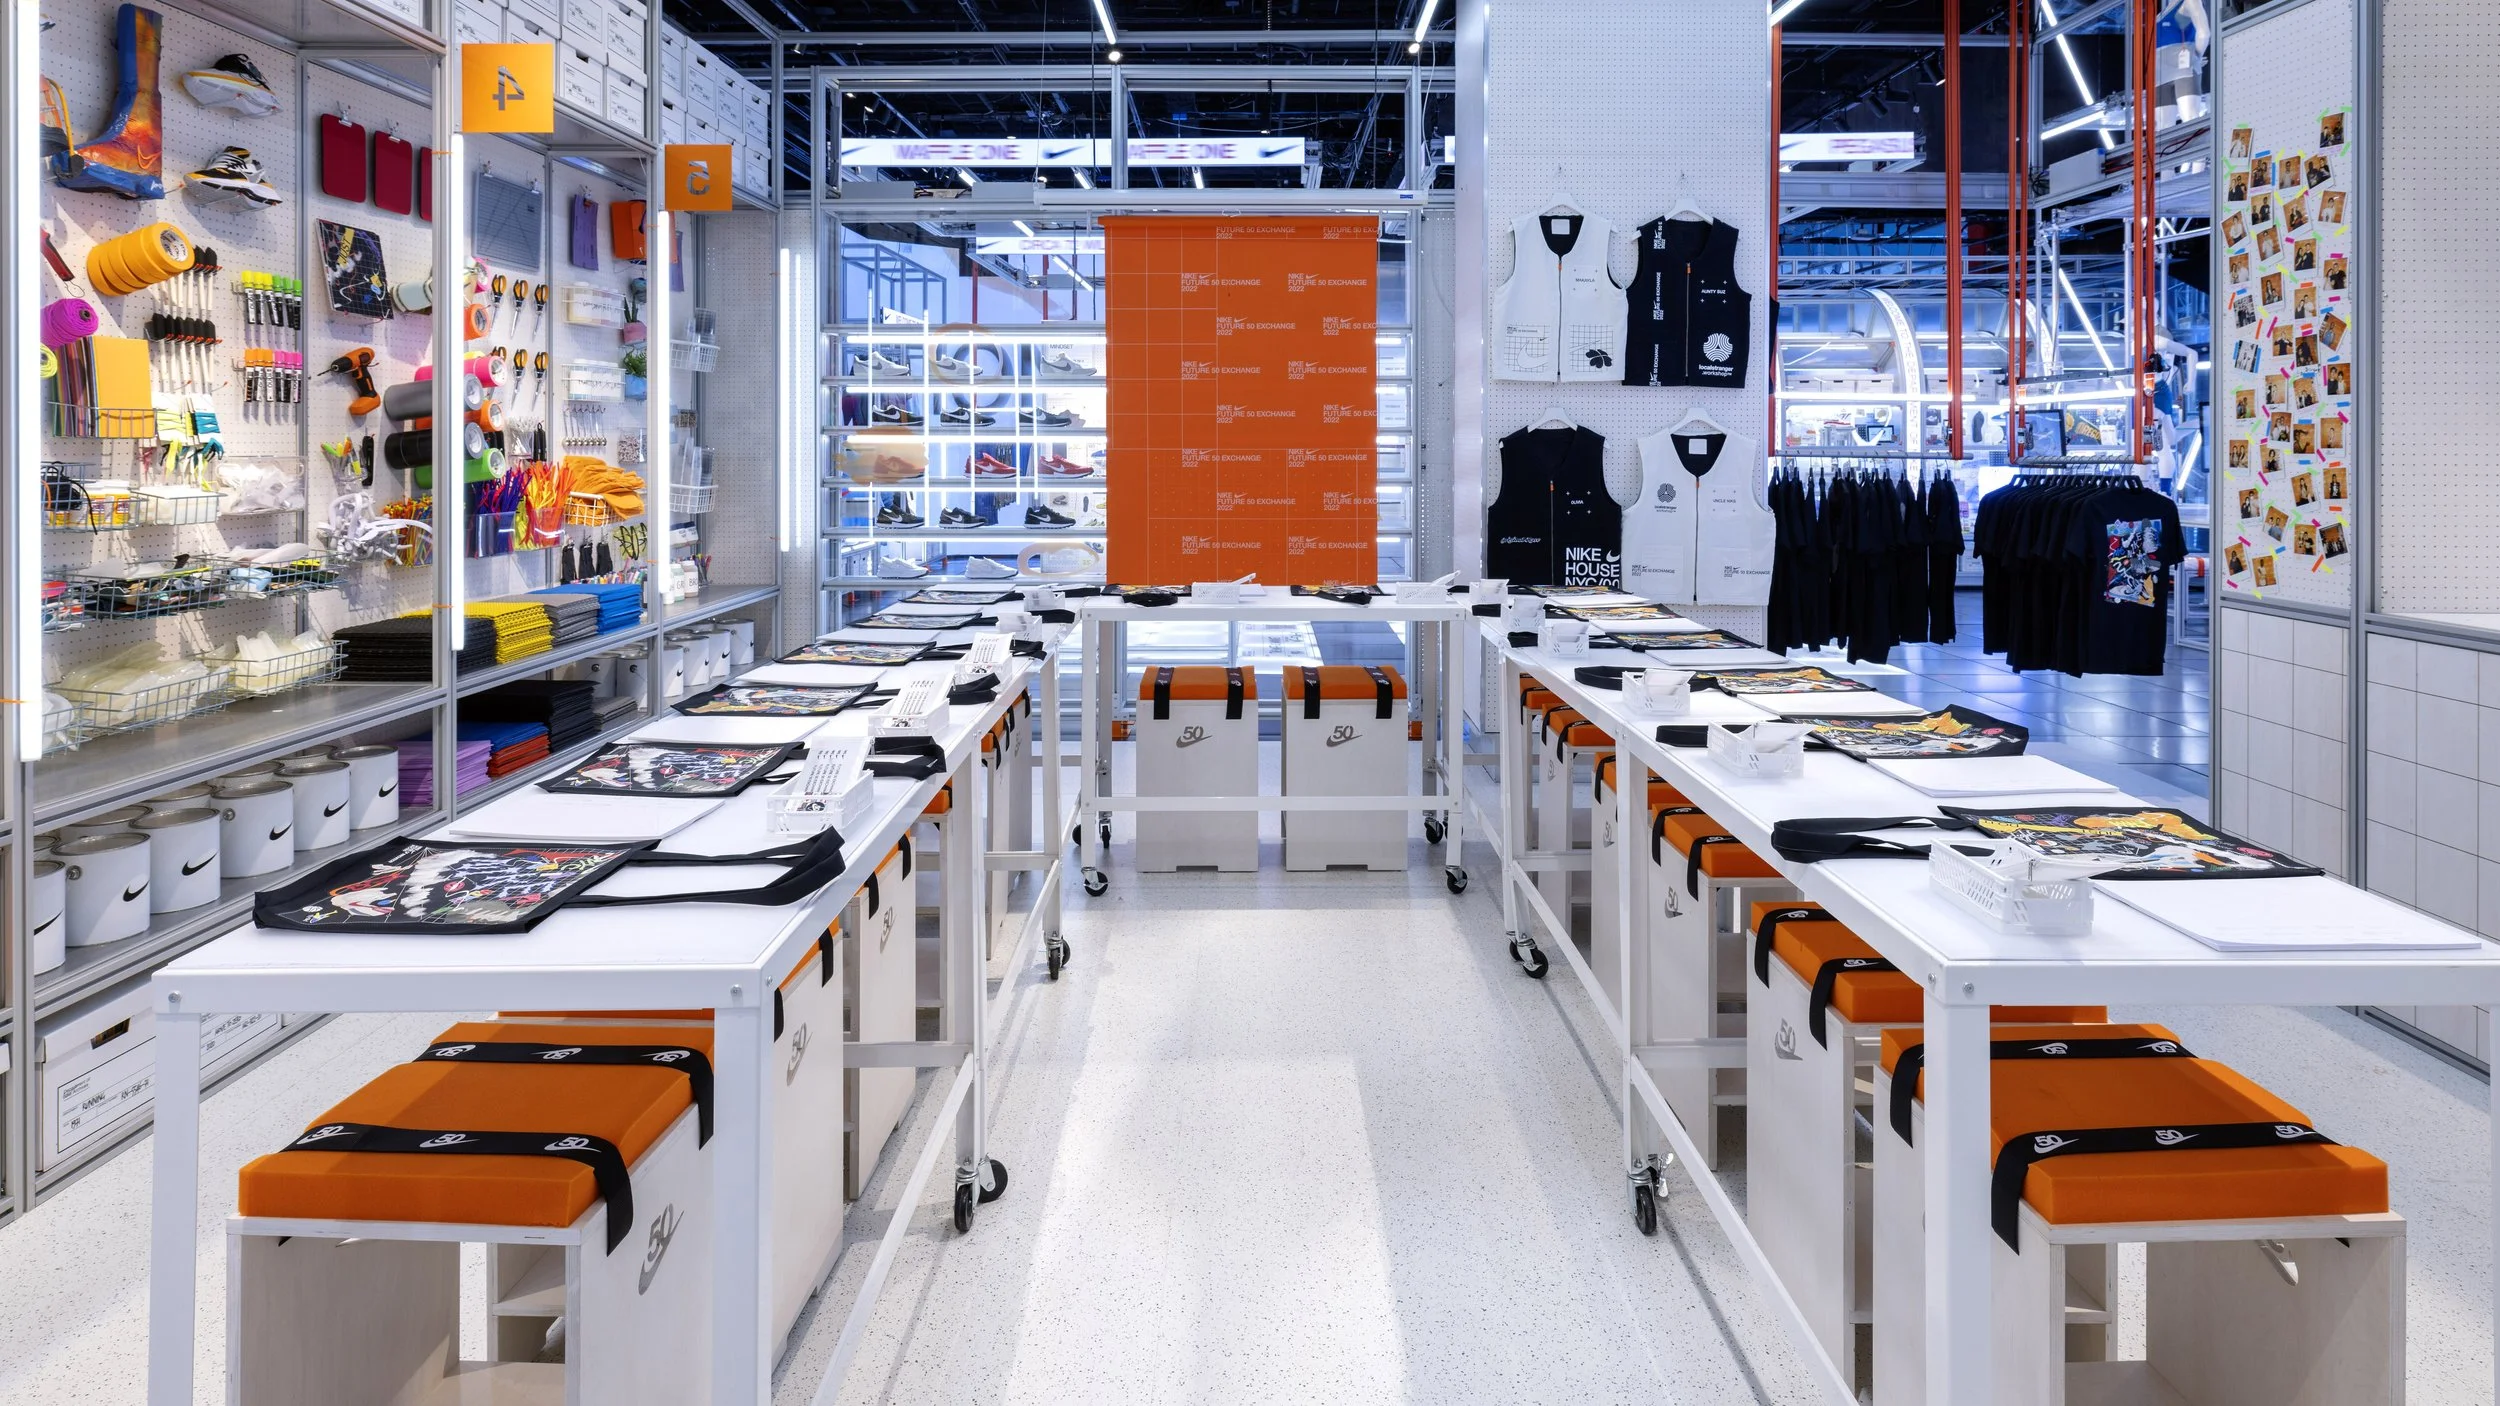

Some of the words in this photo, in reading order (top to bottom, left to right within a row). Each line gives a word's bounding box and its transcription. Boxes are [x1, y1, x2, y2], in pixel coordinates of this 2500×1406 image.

[1566, 547, 1601, 561] NIKE
[1565, 562, 1620, 577] HOUSE
[1183, 726, 1204, 740] 50
[1333, 725, 1354, 740] 50
[435, 1133, 466, 1144] 50
[2155, 1129, 2183, 1144] 50
[2275, 1125, 2304, 1138] 50
[560, 1137, 590, 1150] 50
[2035, 1134, 2063, 1149] 50
